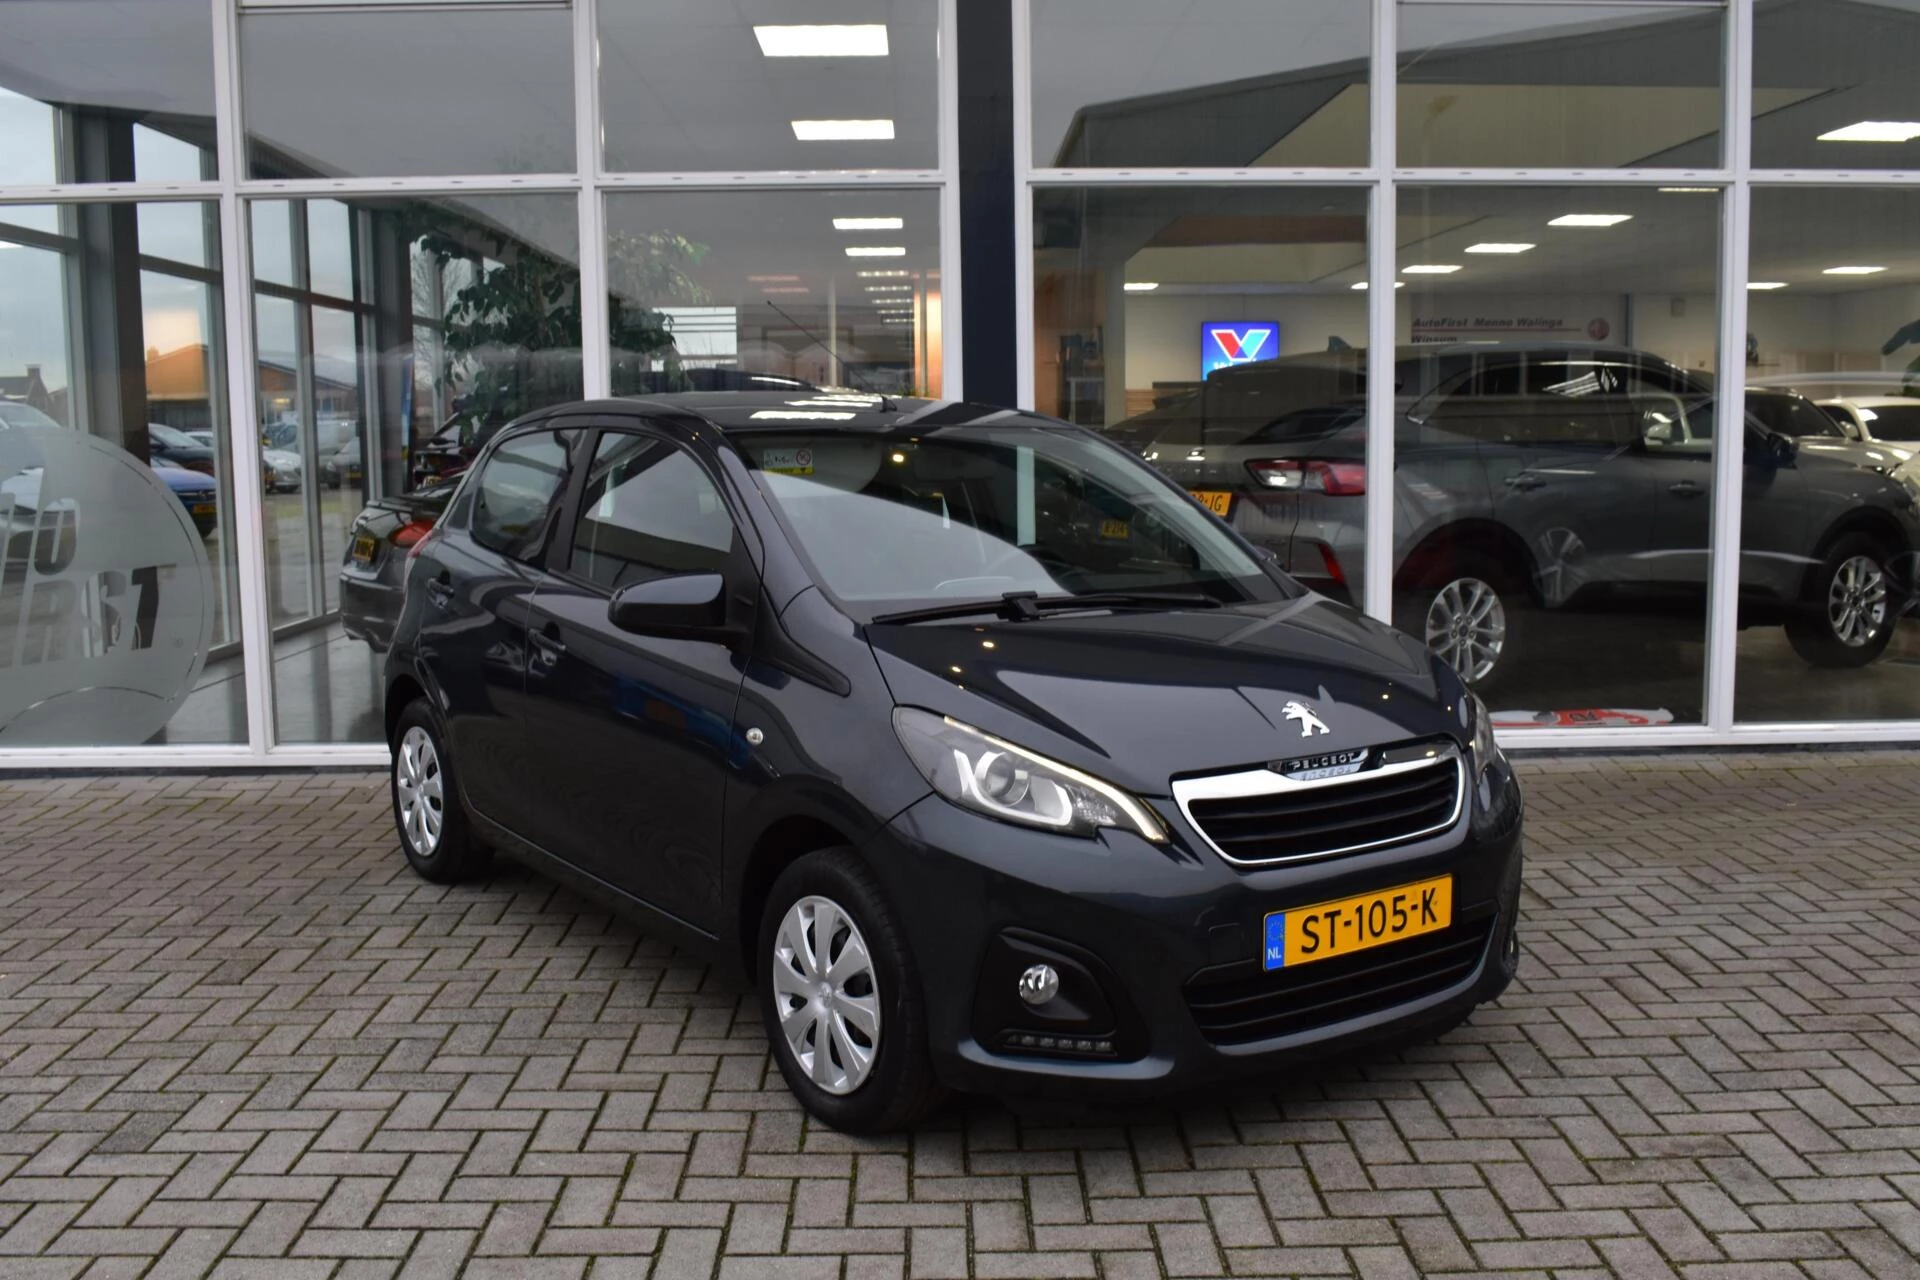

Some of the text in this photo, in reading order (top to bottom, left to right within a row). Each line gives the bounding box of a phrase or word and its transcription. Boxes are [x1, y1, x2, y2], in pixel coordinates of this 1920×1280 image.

[1288, 752, 1355, 770] PEUGEOT
[1301, 887, 1438, 955] ST-105-K
[1267, 946, 1282, 961] NL
